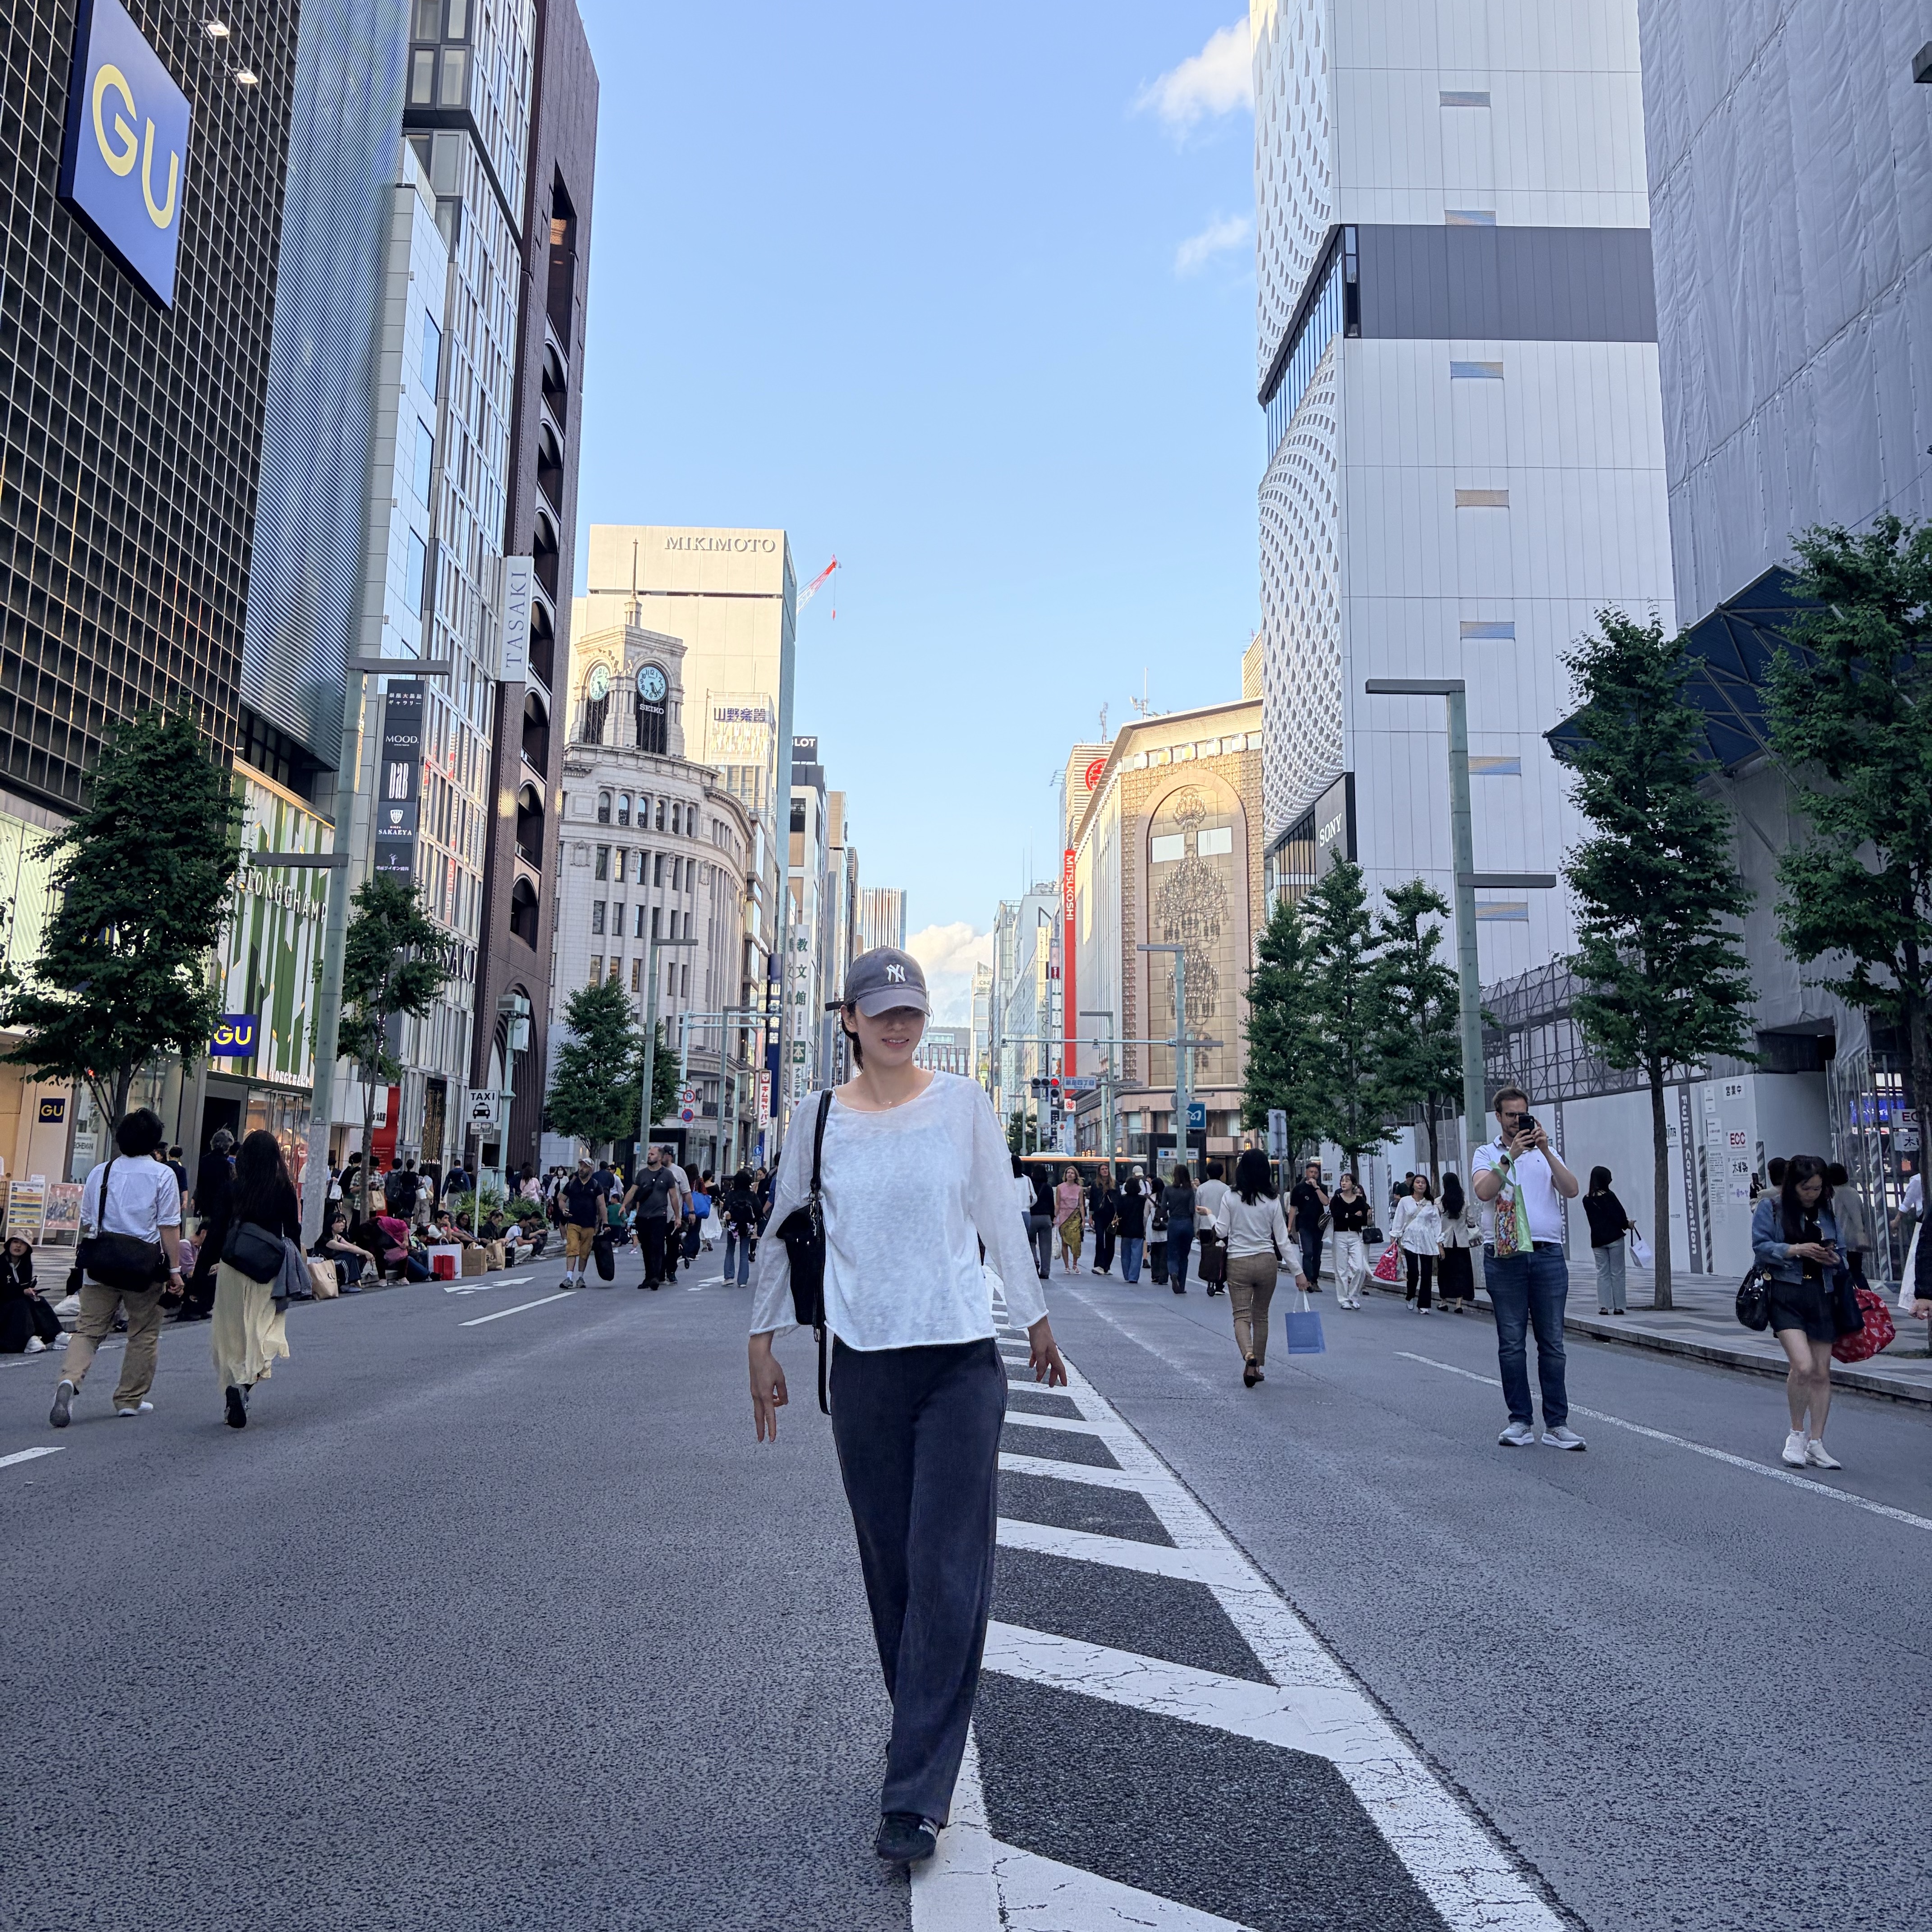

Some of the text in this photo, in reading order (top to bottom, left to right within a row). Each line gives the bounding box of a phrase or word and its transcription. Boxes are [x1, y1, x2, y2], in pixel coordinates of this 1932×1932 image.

[92, 64, 179, 229] GU
[665, 536, 775, 553] MIKIMOTO
[506, 571, 527, 669] TASAKI
[639, 703, 664, 715] SEIKO
[714, 707, 766, 721] 山野楽器
[792, 738, 816, 747] LOT
[1319, 812, 1342, 847] SONY
[247, 867, 327, 923] LONGCHAMP
[1066, 855, 1074, 921] MITSUKOSHI
[795, 937, 808, 1005] 教文館
[886, 964, 906, 982] NY
[213, 1024, 252, 1045] GU
[793, 1044, 805, 1060] 本
[271, 1070, 310, 1088] LONGCHAMP
[470, 1092, 495, 1101] TAXI
[1726, 1084, 1741, 1096] 営業中
[41, 1105, 64, 1116] GU
[760, 1085, 768, 1126] キムラヤのパン
[1730, 1132, 1746, 1145] ECC
[1681, 1095, 1697, 1254] Fujita Corporation
